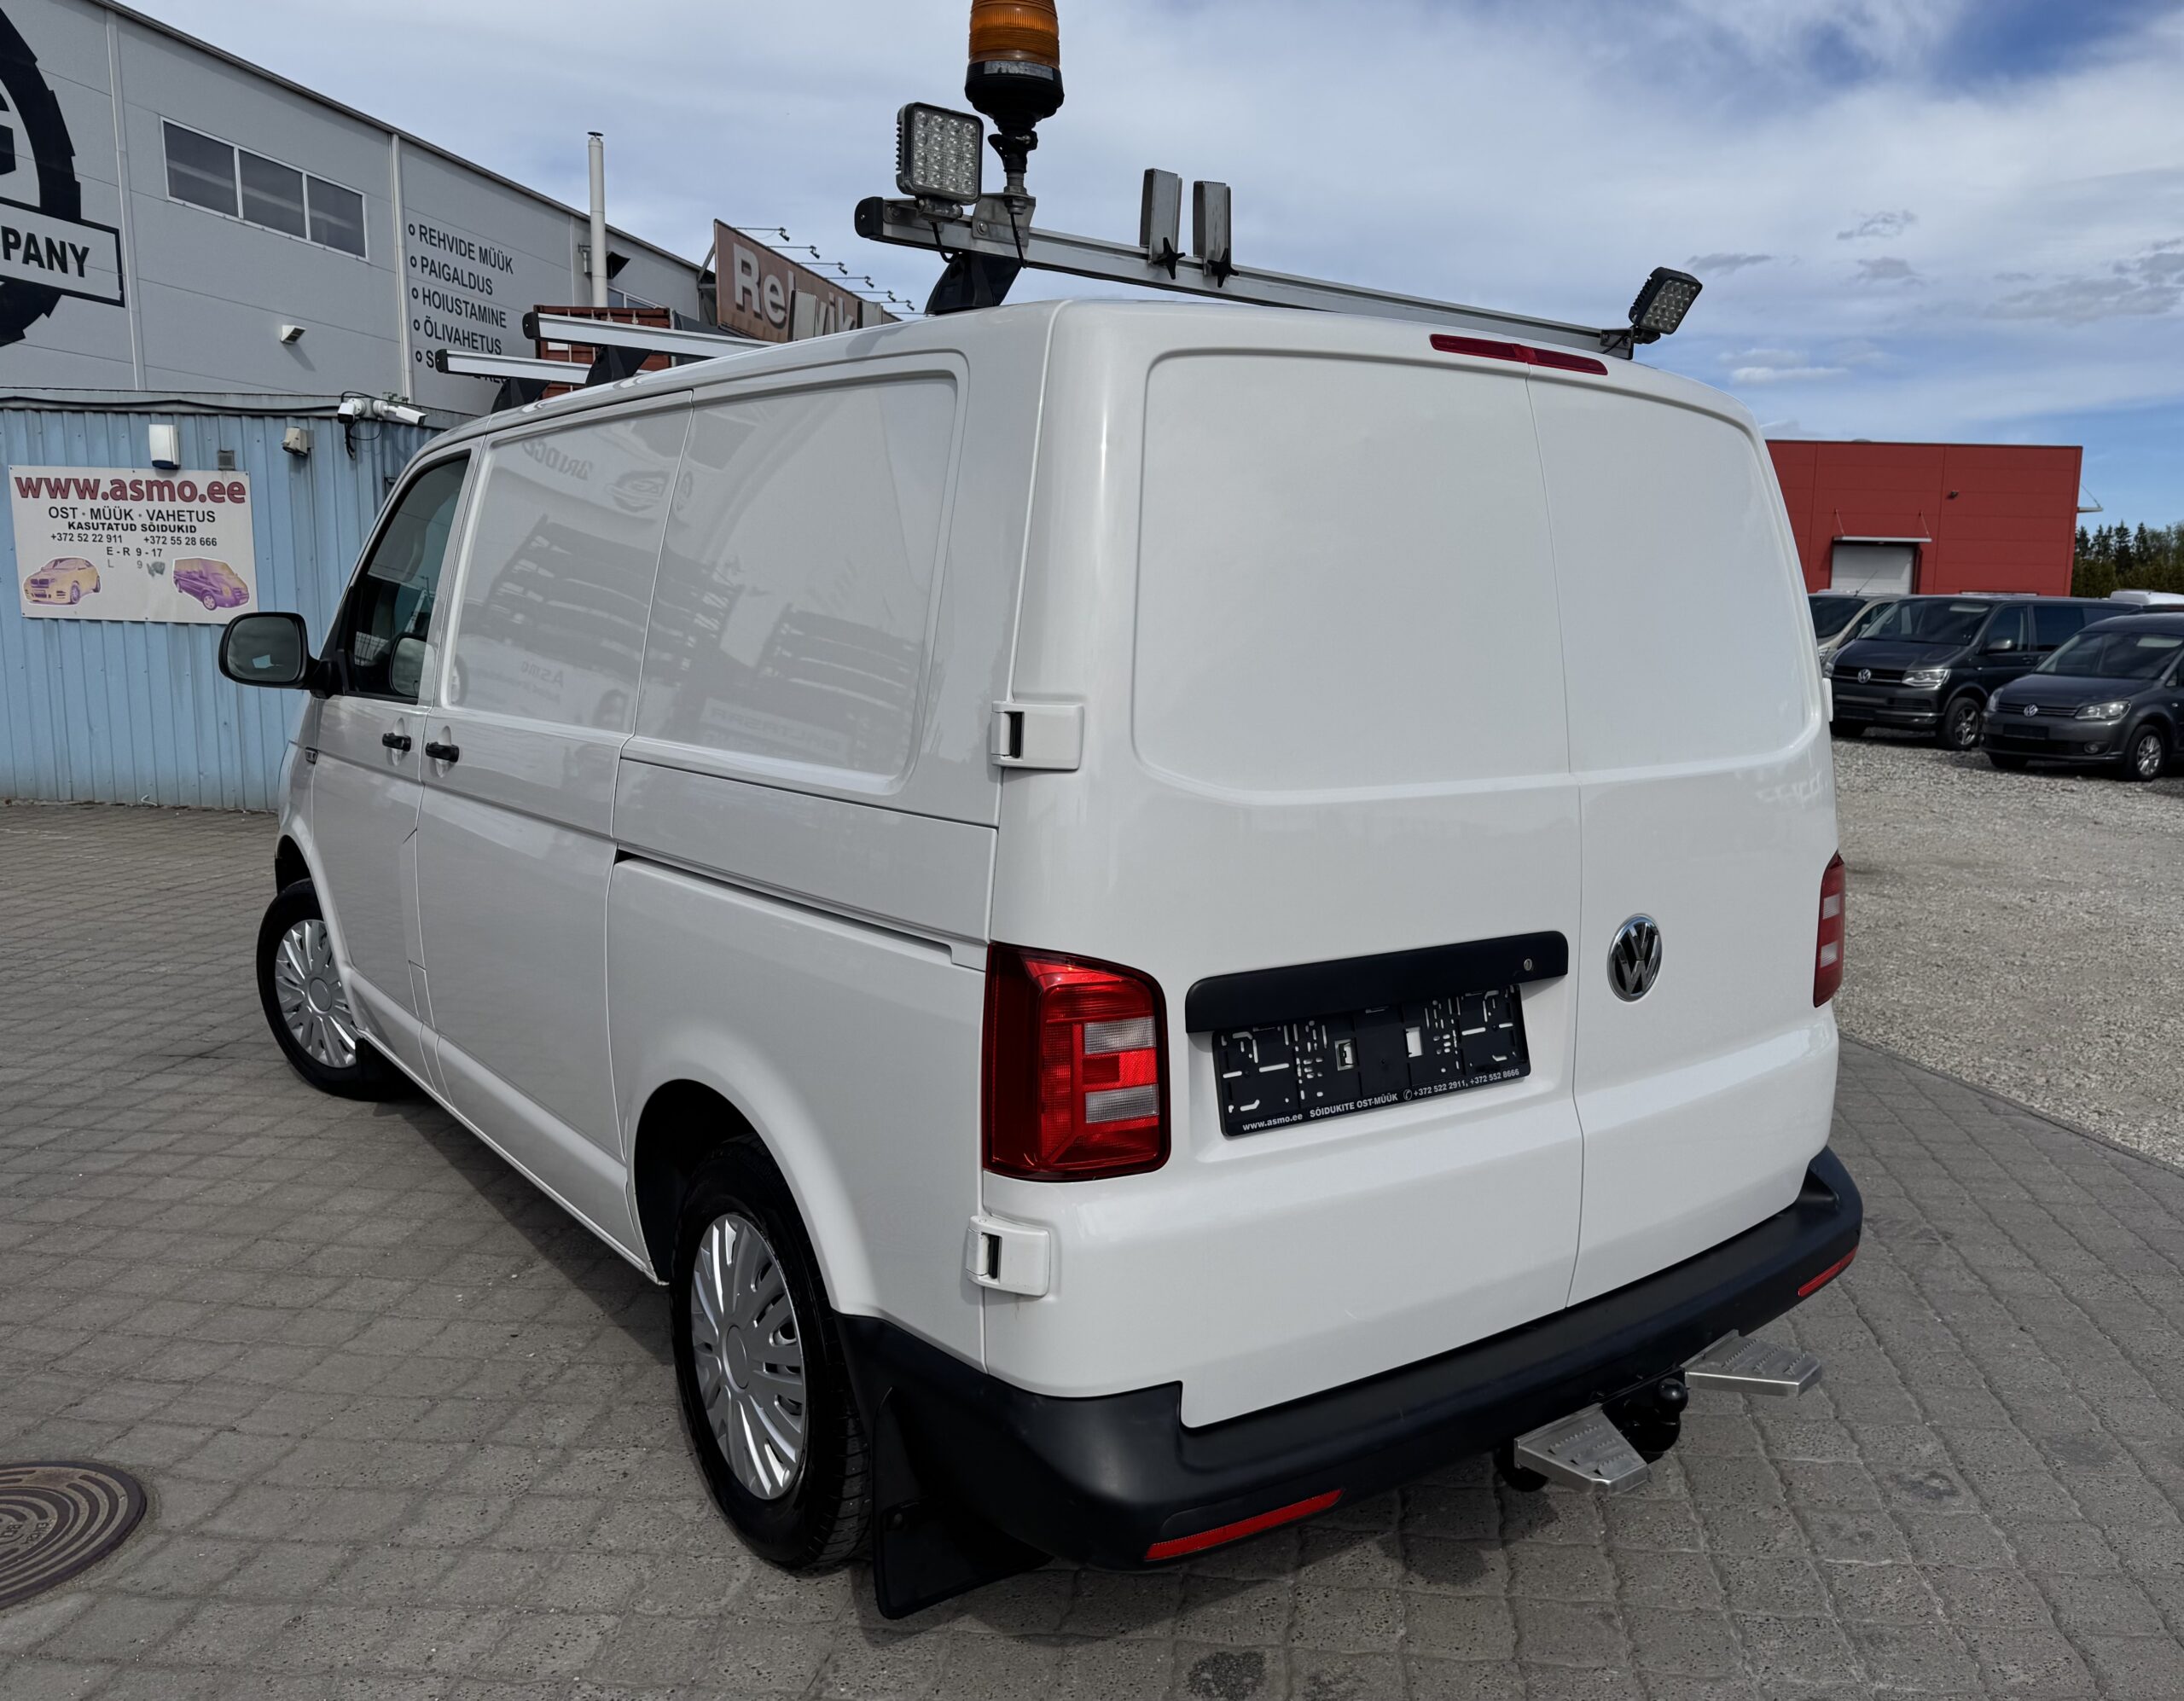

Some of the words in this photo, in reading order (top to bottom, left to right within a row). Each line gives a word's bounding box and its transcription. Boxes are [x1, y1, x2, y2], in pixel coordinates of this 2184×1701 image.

[419, 224, 476, 261] REHVIDE
[479, 246, 514, 275] MÜÜK
[421, 255, 493, 296] PAIGALDUS
[422, 287, 507, 328] HOIUSTAMINE
[423, 316, 502, 356] ÕLIVAHETUS
[15, 476, 247, 504] www.asmo.ee
[48, 506, 78, 520] OST
[90, 505, 134, 521] MÜÜK
[146, 508, 216, 523] VAHETUS
[67, 521, 136, 531] KASUTATUD
[141, 521, 197, 533] SÕIDUKID
[51, 532, 74, 542] +372
[78, 533, 89, 543] 52
[91, 533, 103, 543] 22
[106, 534, 122, 543] 911
[136, 548, 142, 557] 9
[152, 548, 162, 558] 17
[143, 535, 167, 545] +372
[171, 536, 182, 545] 55
[185, 537, 196, 546] 28
[200, 537, 217, 547] 666
[1610, 917, 1660, 1000] VW
[1242, 1112, 1304, 1131] www.asmo.ee
[1310, 1101, 1356, 1118] SÕIDUKITE
[1414, 1086, 1432, 1097] +372
[1434, 1083, 1448, 1093] 522
[1470, 1075, 1488, 1086] +372
[1489, 1071, 1502, 1083] 552
[1502, 1068, 1519, 1079] 8666
